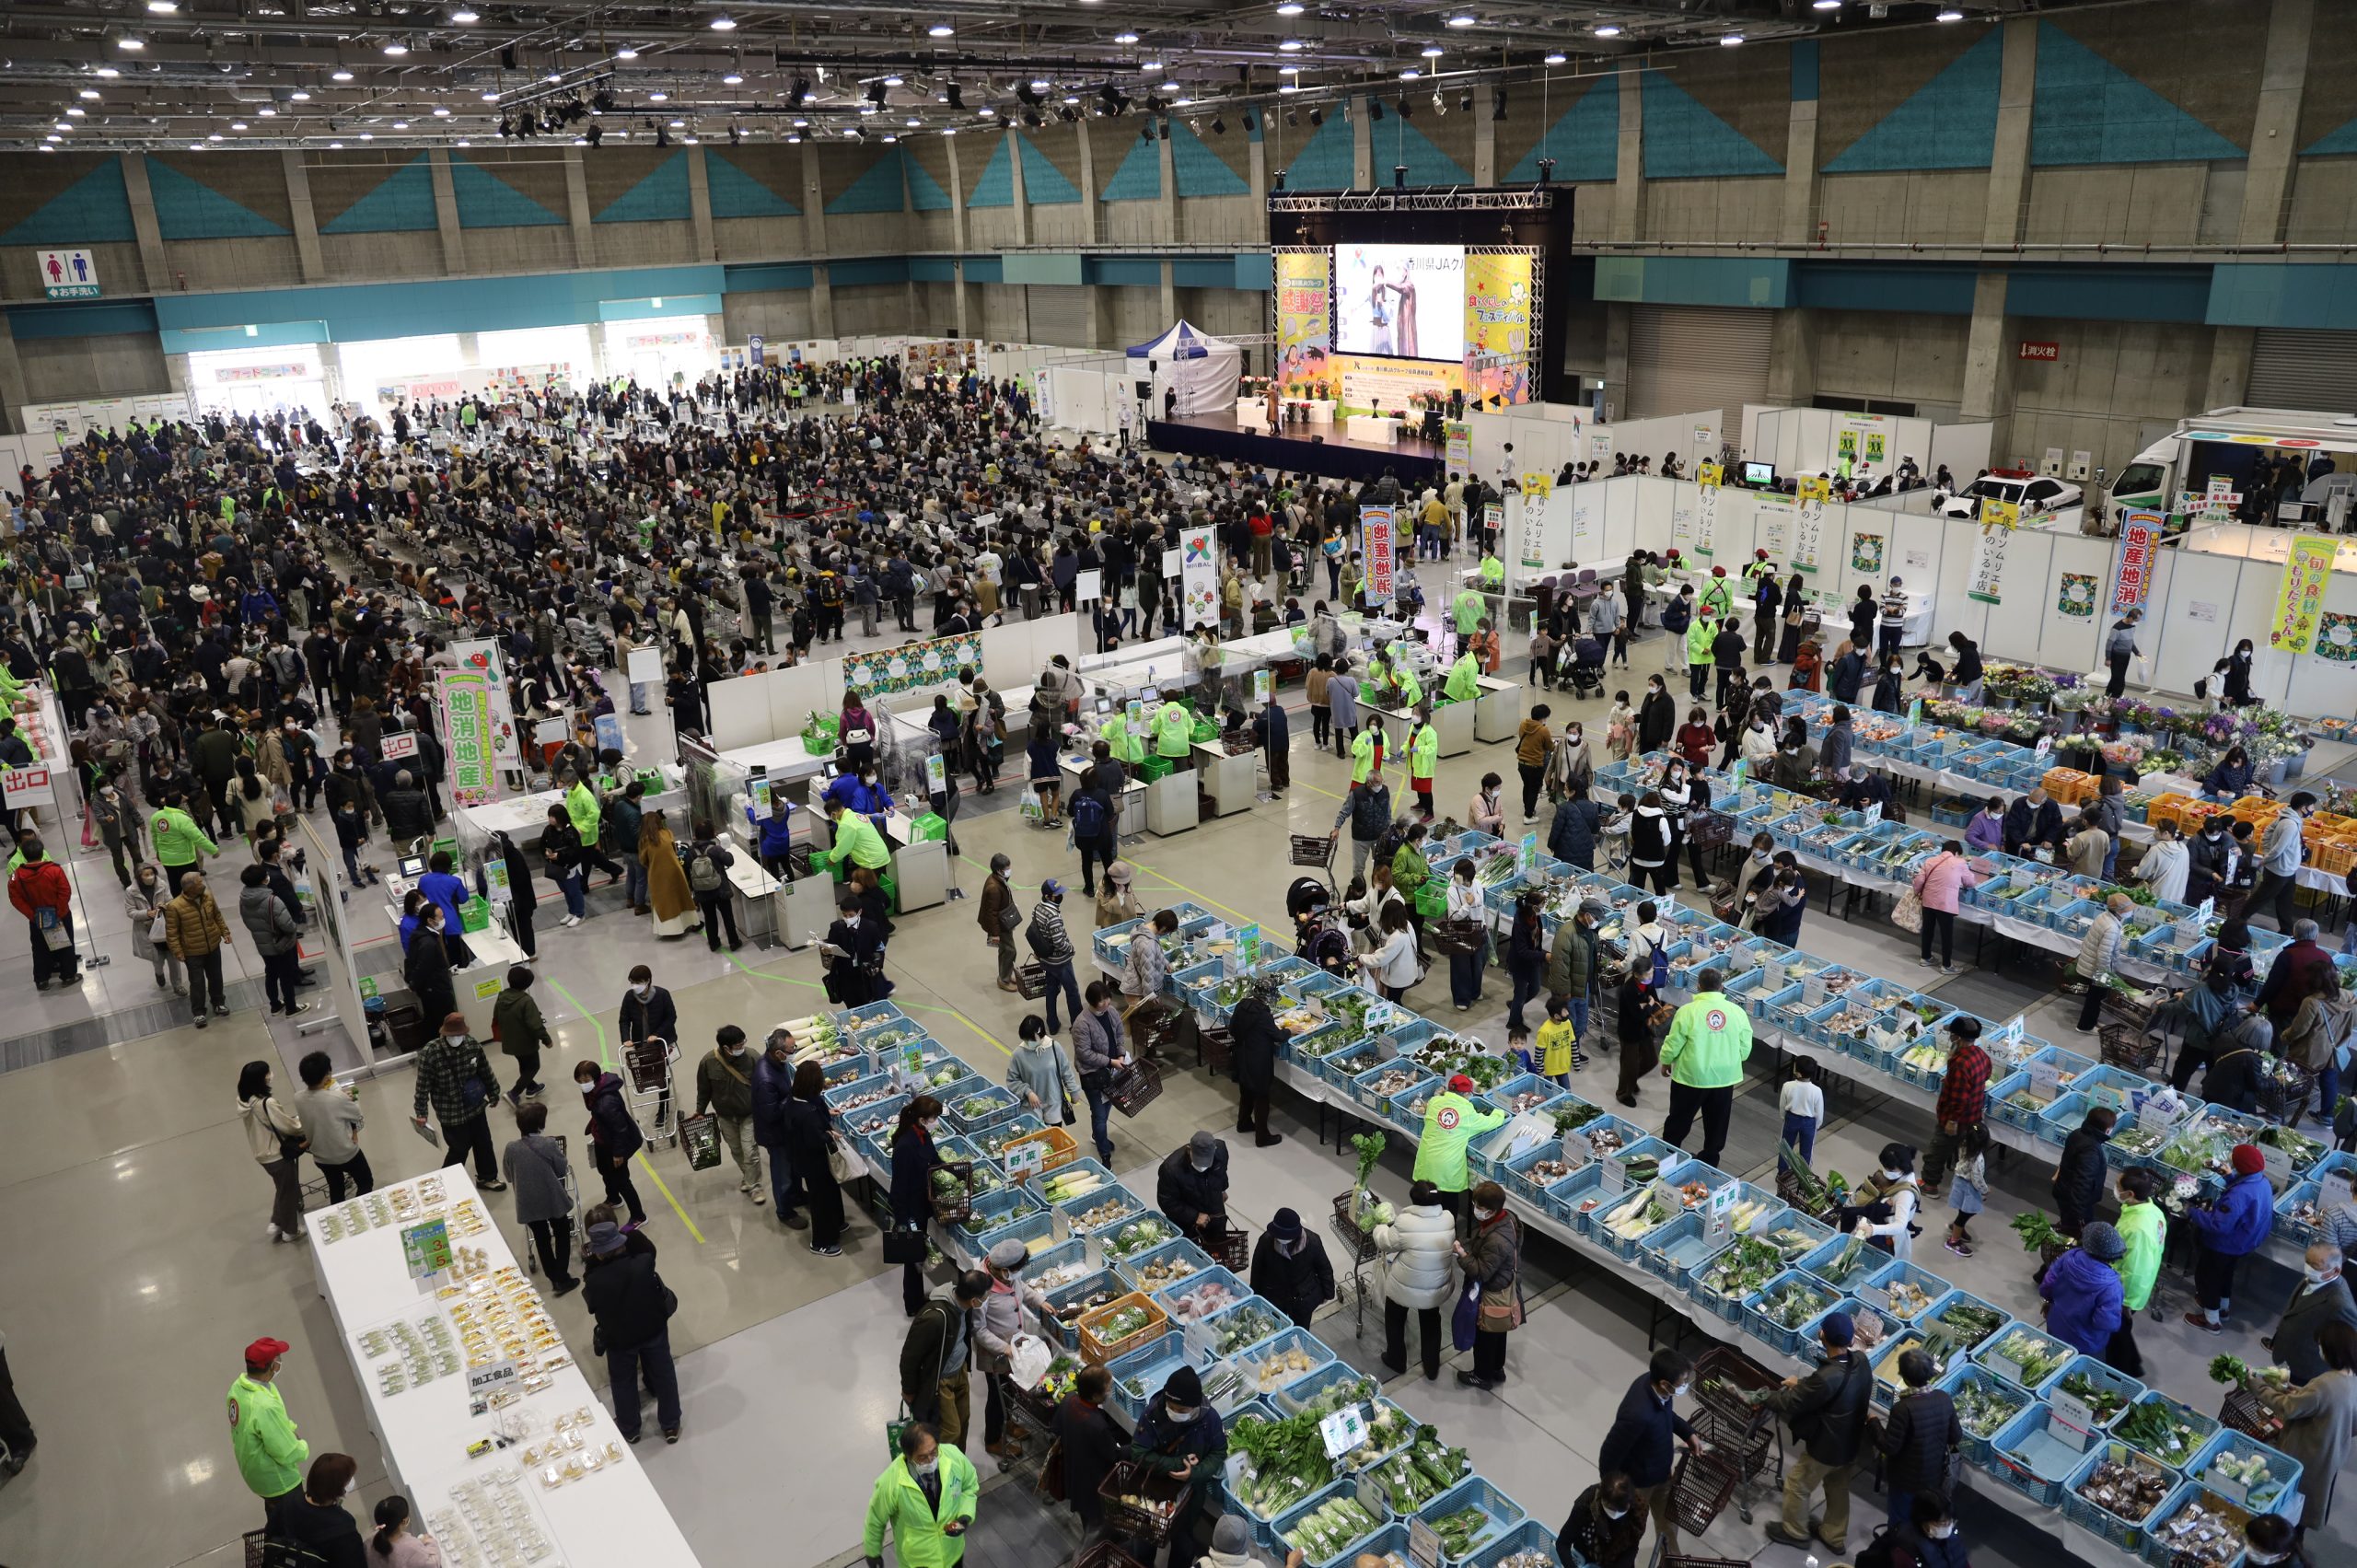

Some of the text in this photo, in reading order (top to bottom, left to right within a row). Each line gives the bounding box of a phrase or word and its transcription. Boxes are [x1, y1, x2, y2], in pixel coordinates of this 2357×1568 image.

[59, 286, 99, 297] お手洗い
[1282, 290, 1325, 314] 感謝祭
[1476, 309, 1526, 323] フェスティバル
[2027, 345, 2056, 357] 消火栓
[1533, 485, 1547, 548] 食育ソムリエ
[1705, 476, 1719, 537] 食育ソムリエ
[1807, 490, 1825, 553] 食育ソムリエ
[2190, 502, 2208, 511] 最後尾
[1523, 506, 1534, 558] のいるお店
[1796, 510, 1810, 562] のいるお店
[1991, 515, 2011, 583] 食育ソムリエ
[1977, 536, 1995, 591] のいるお店
[2118, 528, 2147, 603] 地産地消
[2282, 564, 2304, 637] もりたくさん
[2303, 556, 2326, 614] 旬の食材
[383, 738, 412, 755] 出口
[448, 691, 482, 787] 地消地産
[6, 770, 48, 794] 出口
[1368, 1008, 1388, 1022] 野菜
[1010, 1150, 1037, 1167] 野菜
[1715, 1188, 1736, 1208] 野菜
[471, 1367, 514, 1387] 加工食品
